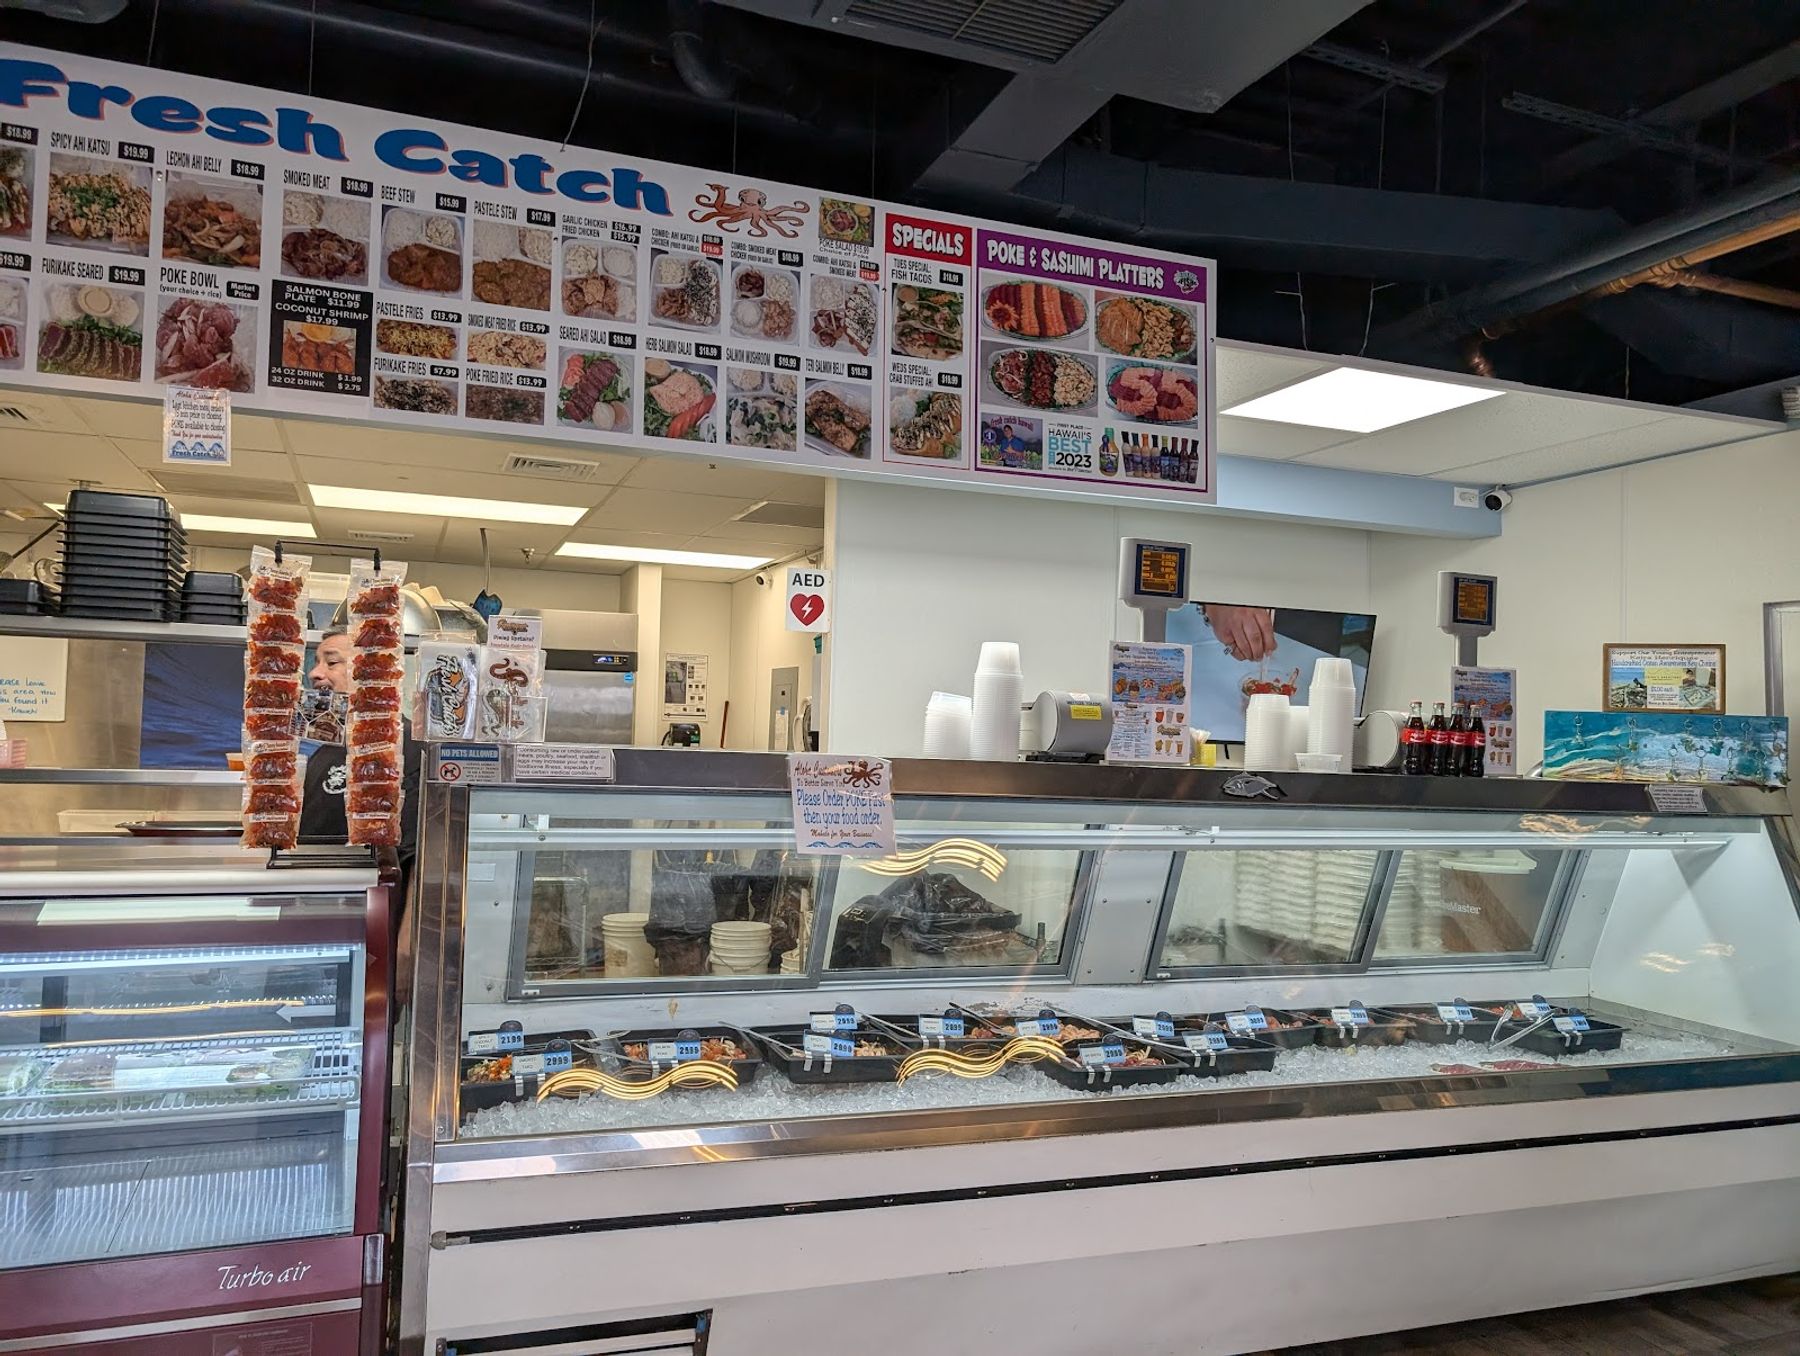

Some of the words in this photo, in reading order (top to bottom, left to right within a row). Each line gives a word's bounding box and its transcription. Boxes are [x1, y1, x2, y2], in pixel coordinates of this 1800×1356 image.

[0, 58, 347, 163] Fresh
[372, 127, 674, 217] Catch
[50, 132, 73, 149] SPICY
[73, 135, 87, 152] AHI
[87, 139, 111, 156] KATSU
[124, 145, 149, 159] $19.99
[166, 150, 191, 168] LECHON
[191, 155, 203, 170] AHI
[203, 157, 223, 173] BELLY
[283, 169, 311, 188] SMOKED
[312, 174, 331, 190] MEAT
[381, 185, 397, 201] BEEF
[398, 188, 416, 204] STEW
[474, 200, 500, 218] PASTELE
[501, 205, 518, 221] STEW
[562, 214, 583, 225] GARLIC
[584, 217, 608, 230] CHICKEN
[562, 224, 577, 234] FRIED
[578, 228, 601, 238] CHICKEN
[835, 241, 853, 252] SALAD
[892, 222, 966, 259] SPECIALS
[42, 257, 77, 278] FURIKAKE
[77, 261, 104, 281] SEARED
[113, 269, 140, 283] $19.99
[894, 257, 908, 270] TUES
[987, 239, 1025, 266] POKE
[1030, 246, 1037, 268] &
[1041, 246, 1094, 279] SASHIMI
[1098, 257, 1164, 291] PLATTERS
[160, 267, 188, 285] POKE
[189, 271, 220, 289] BOWL
[892, 268, 908, 282] FISH
[909, 271, 933, 285] TACOS
[178, 285, 201, 296] choice
[230, 283, 256, 293] Market
[233, 289, 252, 299] Price
[285, 284, 331, 298] SALMON
[332, 291, 362, 302] BONE
[284, 292, 317, 303] PLATE
[327, 297, 361, 309] $11.99
[275, 301, 328, 317] COCONUT
[328, 309, 370, 322] SHRIMP
[304, 314, 340, 326] $17.99
[376, 301, 404, 318] PASTELE
[405, 305, 424, 321] FRIES
[559, 325, 580, 342] SEARED
[580, 328, 590, 343] AHI
[590, 329, 607, 346] SALAD
[677, 341, 692, 356] SALAD
[271, 366, 282, 375] 24
[283, 367, 296, 376] OZ
[297, 369, 325, 379] DRINK
[374, 356, 407, 374] FURIKAKE
[408, 360, 428, 377] FRIES
[892, 362, 908, 374] WEDS
[271, 375, 283, 384] 32
[283, 377, 296, 385] OZ
[297, 378, 325, 388] DRINK
[466, 367, 481, 383] POKE
[482, 370, 499, 385] FRIED
[500, 372, 514, 386] RICE
[889, 372, 902, 384] CRAB
[903, 374, 924, 387] STUFFED
[1049, 427, 1092, 440] HAWAII'S
[1049, 436, 1092, 454] BEST
[1055, 452, 1092, 468] 2023
[792, 572, 825, 588] AED
[441, 749, 452, 758] NO
[452, 749, 467, 758] PETS
[468, 750, 498, 759] ALLOWED
[797, 789, 822, 806] Please
[822, 789, 845, 807] Order
[804, 807, 822, 824] then
[823, 812, 840, 829] your
[841, 807, 859, 825] food
[217, 1263, 274, 1290] Turbo
[277, 1260, 312, 1284] air
